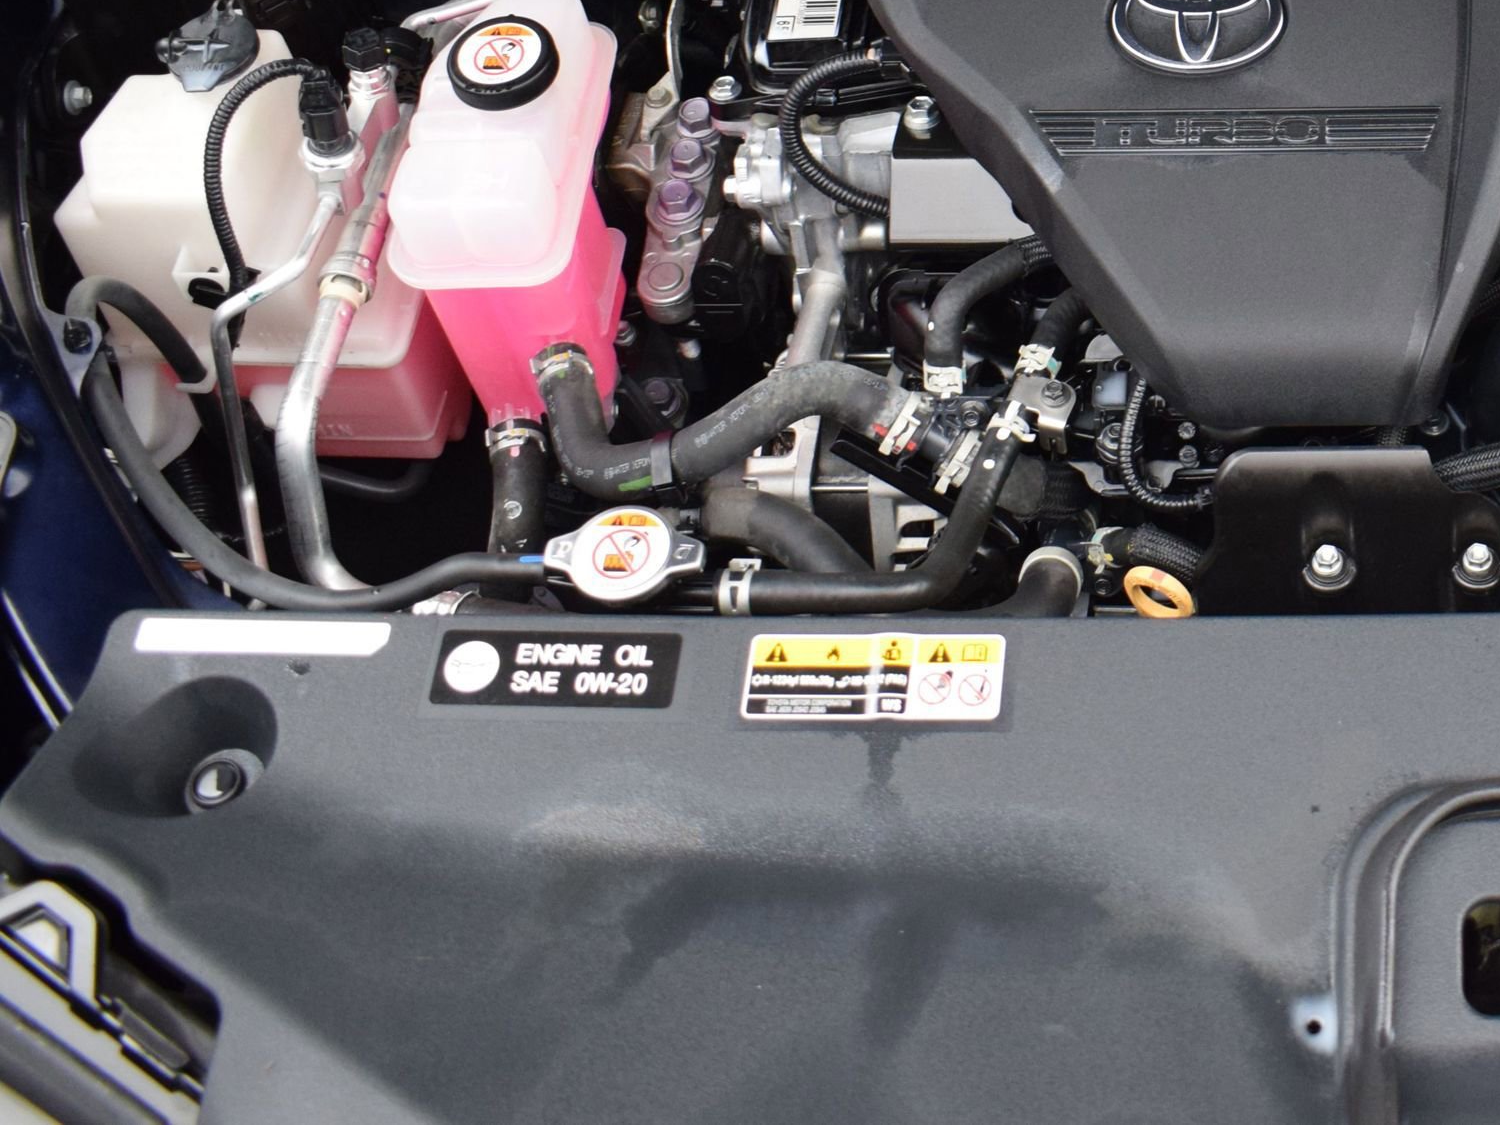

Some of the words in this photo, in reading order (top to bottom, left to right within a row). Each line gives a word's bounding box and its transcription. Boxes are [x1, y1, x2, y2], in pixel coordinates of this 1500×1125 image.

[1102, 116, 1323, 145] TURBO
[515, 643, 603, 666] ENGINE
[615, 644, 654, 667] OIL
[510, 670, 560, 694] SAE
[574, 672, 648, 695] 0W-20
